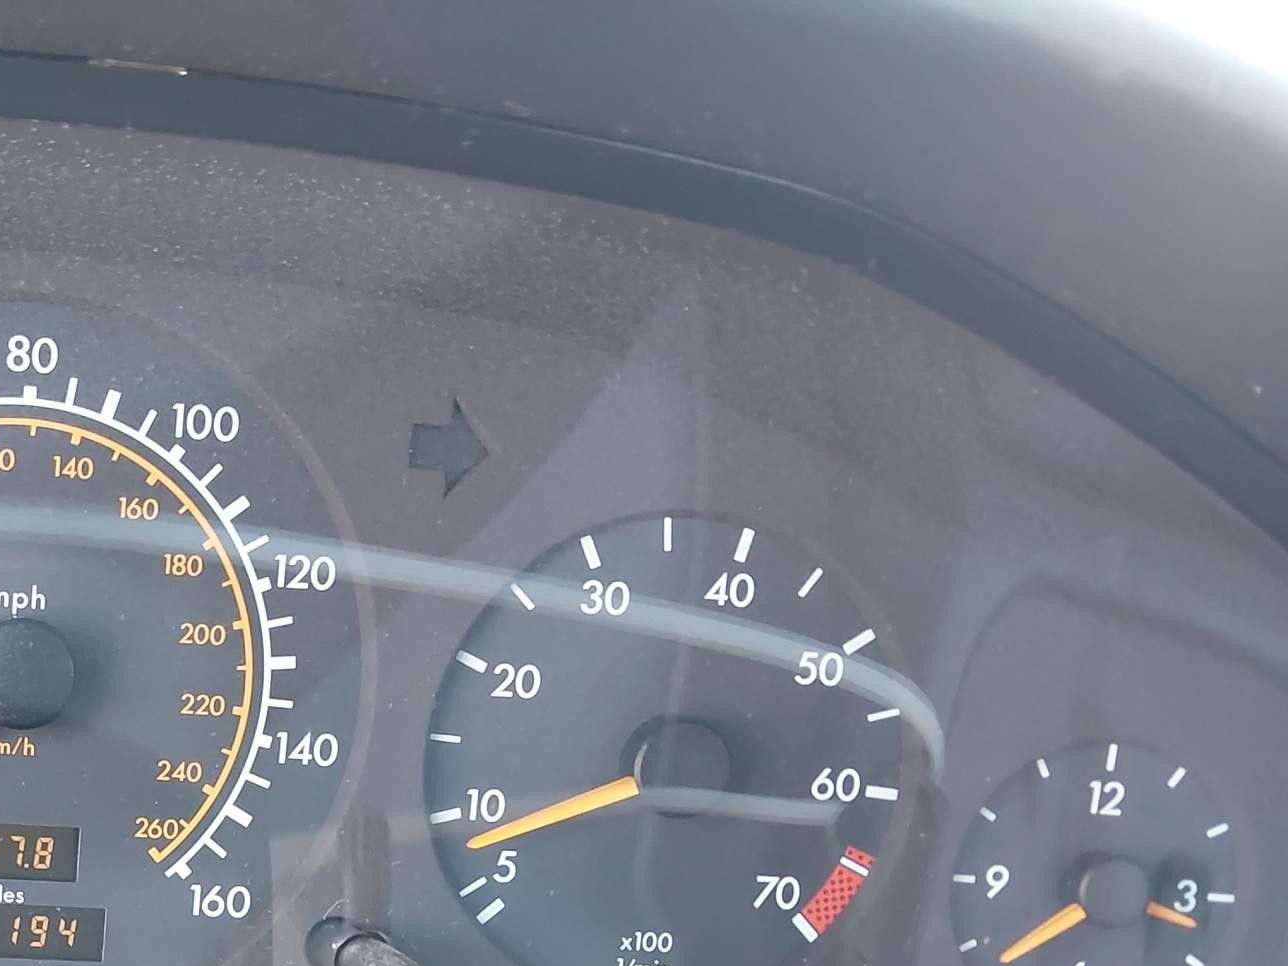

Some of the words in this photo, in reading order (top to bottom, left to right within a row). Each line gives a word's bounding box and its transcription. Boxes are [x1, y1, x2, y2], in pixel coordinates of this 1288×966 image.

[5, 335, 59, 374] 80
[171, 403, 240, 442] 100
[52, 456, 95, 481] 140
[118, 497, 160, 522] 160
[162, 554, 204, 578] 180
[274, 554, 336, 592] 120
[579, 580, 630, 616] 30
[704, 573, 755, 608] 40
[179, 623, 226, 647] 200
[491, 664, 541, 699] 20
[793, 652, 843, 687] 50
[179, 694, 226, 717] 220
[275, 731, 339, 768] 140
[156, 760, 202, 784] 240
[811, 768, 861, 802] 60
[465, 788, 506, 822] 10
[1089, 780, 1125, 817] 12
[134, 817, 179, 841] 260
[492, 850, 518, 884] 5
[986, 864, 1010, 899] 9
[190, 884, 251, 919] 160
[753, 875, 800, 910] 70
[1173, 879, 1198, 913] 3
[620, 932, 673, 953] x100
